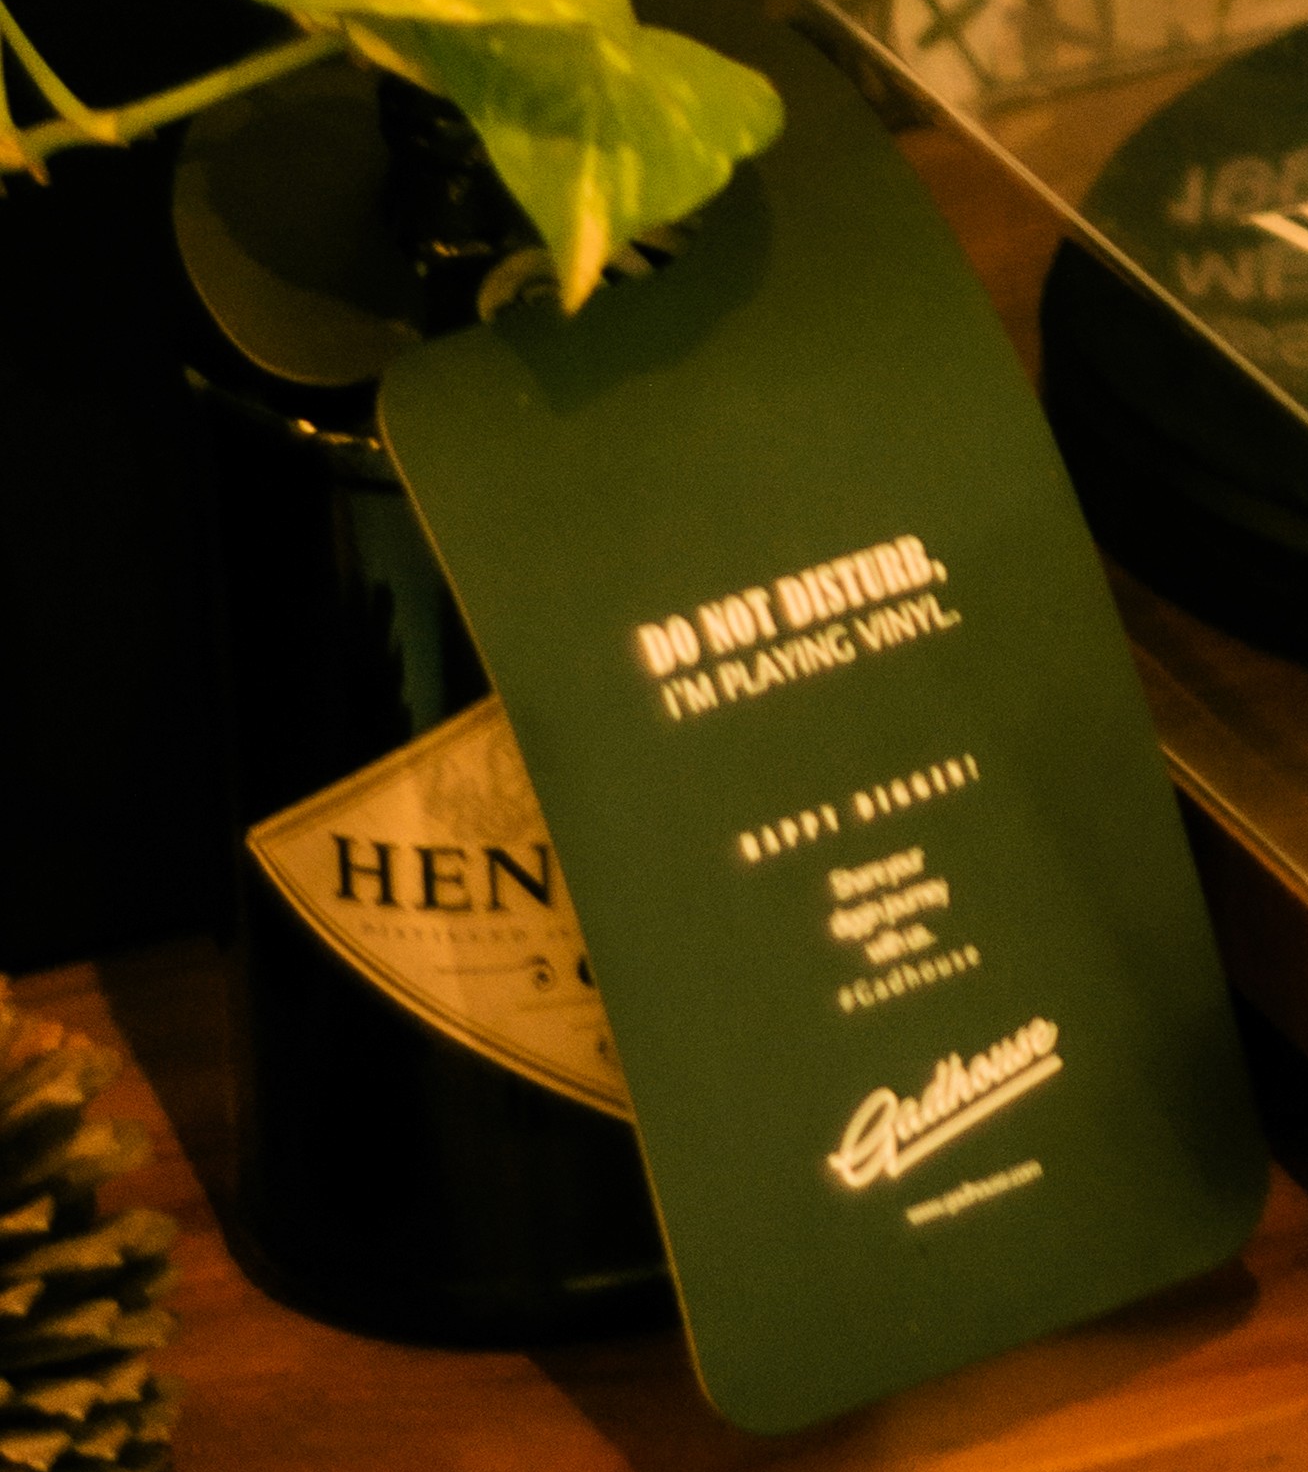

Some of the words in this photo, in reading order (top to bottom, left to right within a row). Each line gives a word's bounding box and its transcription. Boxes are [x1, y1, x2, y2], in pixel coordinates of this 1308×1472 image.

[636, 614, 700, 677] DO
[698, 585, 777, 655] NOT
[775, 533, 947, 629] DISTURB,
[660, 671, 719, 721] I'M
[716, 623, 856, 701] PLAYING
[855, 592, 962, 652] VINYL.
[332, 834, 556, 914] HEN
[740, 802, 839, 862] HAPPY
[827, 1017, 1062, 1187] Gadhouse
